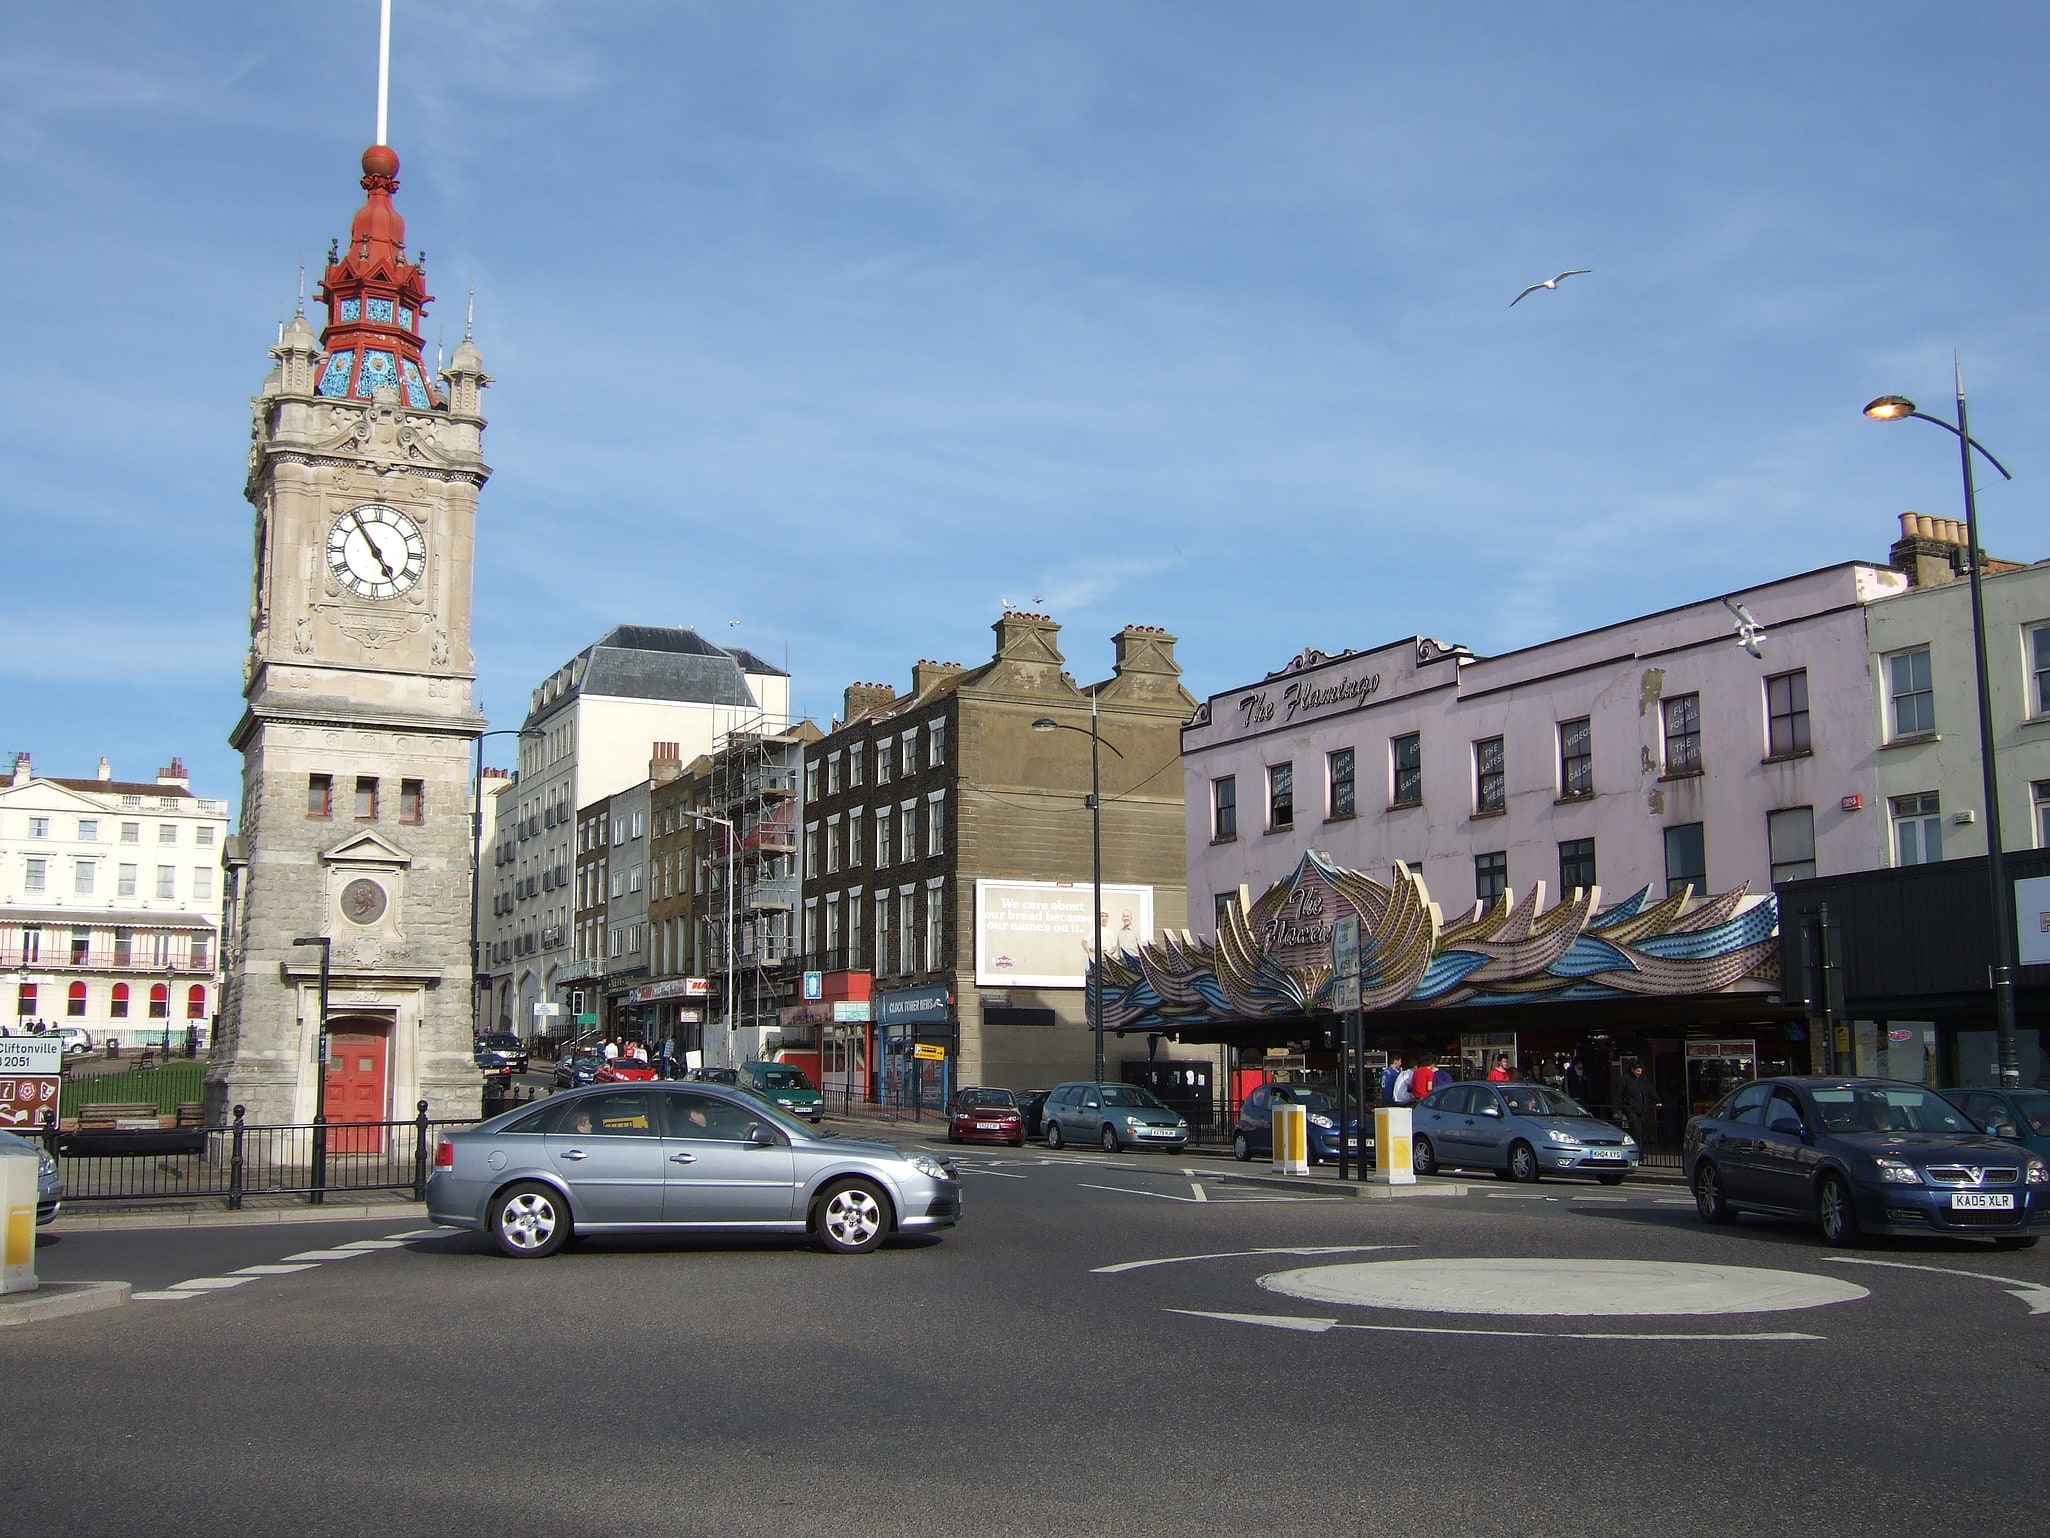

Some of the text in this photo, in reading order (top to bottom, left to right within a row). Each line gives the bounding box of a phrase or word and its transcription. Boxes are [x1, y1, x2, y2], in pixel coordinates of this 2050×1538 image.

[1237, 673, 1380, 728] The Flamingo
[1673, 698, 1691, 717] FUN
[1670, 709, 1699, 732] FOR ALL
[1484, 743, 1498, 758] THE
[1674, 737, 1692, 753] THE
[1337, 753, 1350, 769] FUN
[1568, 761, 1592, 782] GALOR
[1339, 783, 1351, 797] THE
[1483, 775, 1504, 794] GAME
[1337, 792, 1355, 807] FAMIL
[1001, 897, 1085, 912] We care about
[1289, 886, 1324, 920] The
[985, 909, 1093, 923] our bread because
[986, 921, 1009, 931] our
[1009, 921, 1051, 932] name's
[1053, 923, 1069, 932] on
[1956, 1195, 2008, 1206] KA05 XLR
